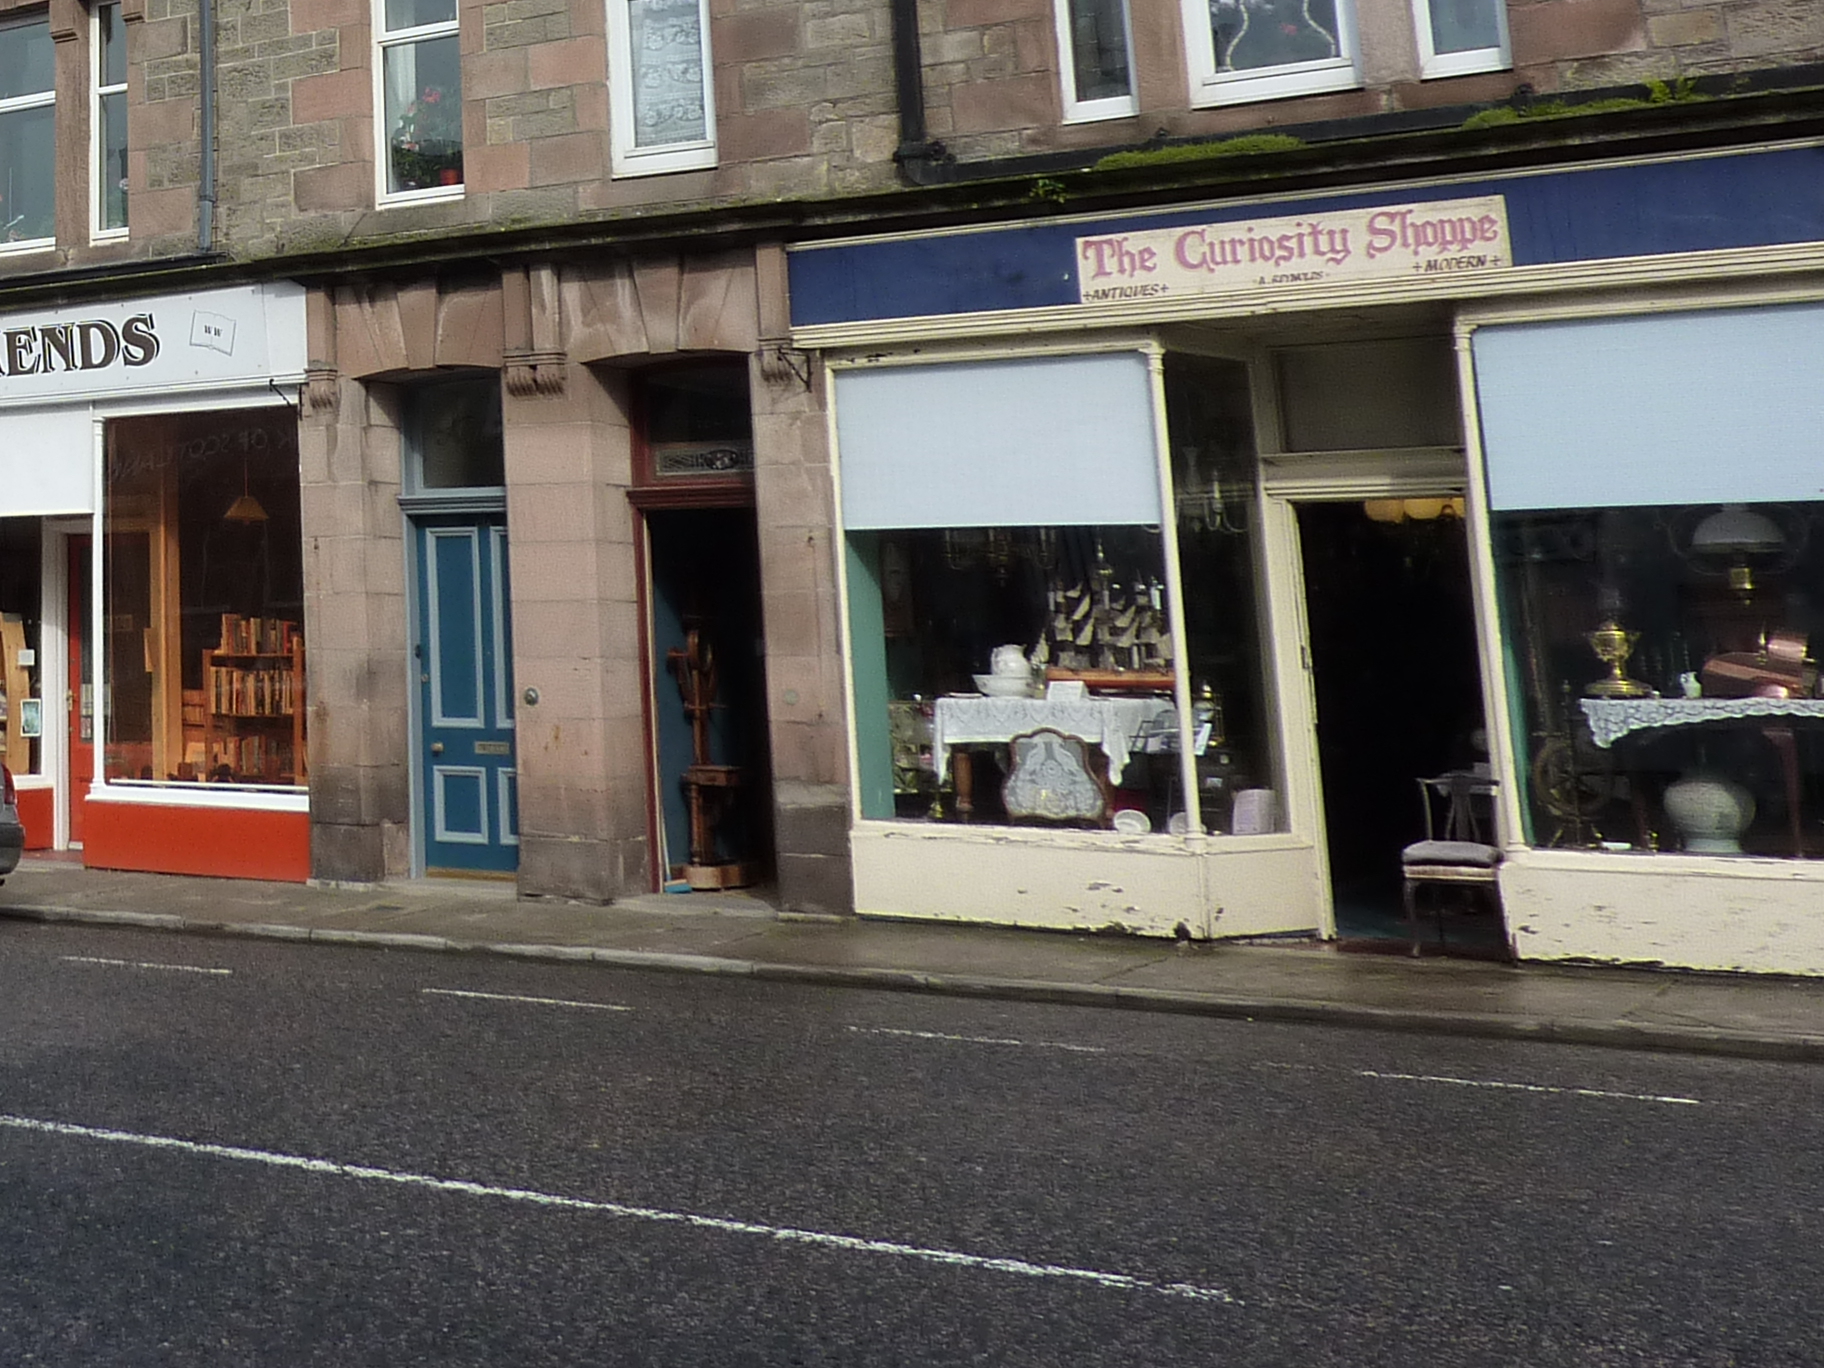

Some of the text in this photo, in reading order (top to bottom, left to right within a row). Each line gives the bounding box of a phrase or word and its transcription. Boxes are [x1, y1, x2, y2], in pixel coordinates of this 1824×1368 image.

[1082, 209, 1499, 278] The Curiosity Shoppe
[1424, 254, 1488, 272] MODERN
[1091, 283, 1160, 300] ANTIQUES
